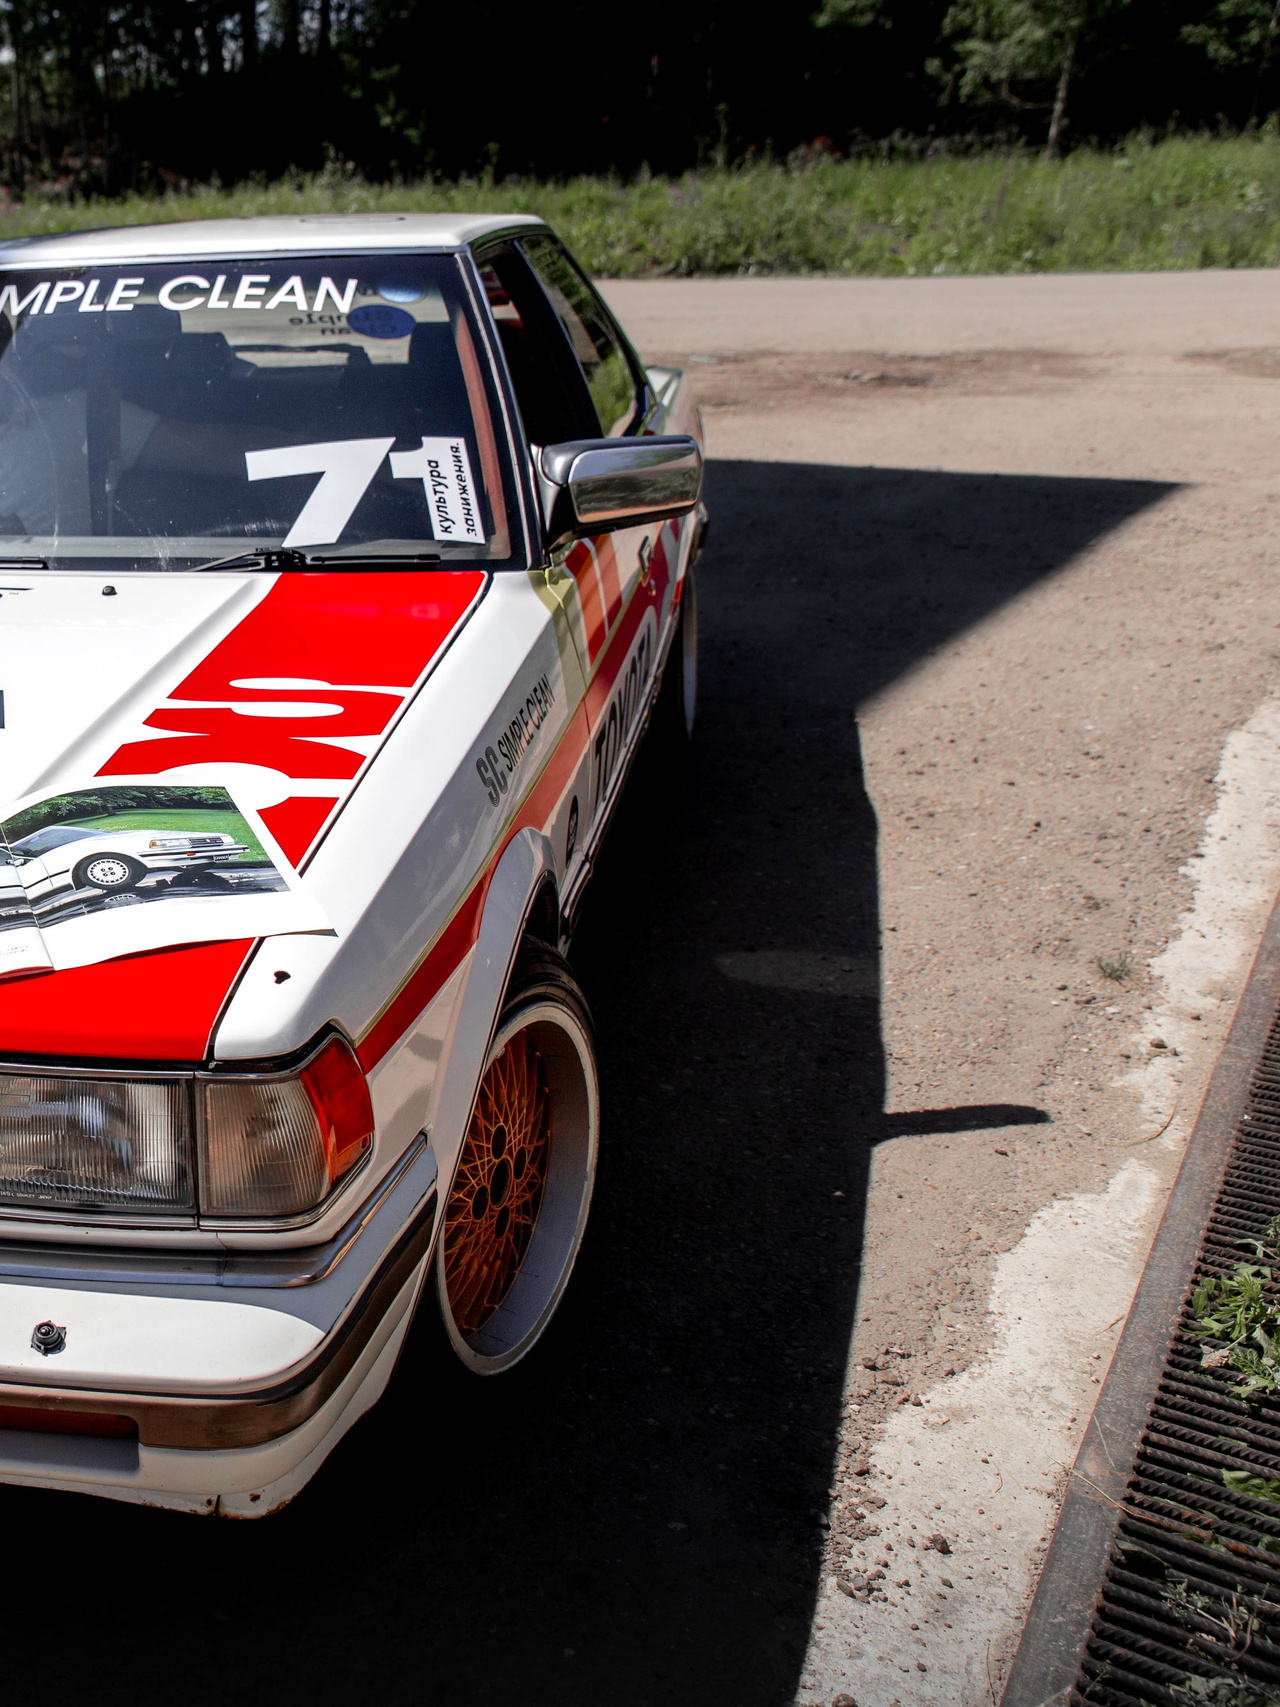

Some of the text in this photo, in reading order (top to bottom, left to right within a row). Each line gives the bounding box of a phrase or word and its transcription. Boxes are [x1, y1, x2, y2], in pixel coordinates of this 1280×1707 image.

[157, 274, 358, 314] CLEAN
[245, 435, 486, 548] 71
[497, 707, 535, 773] SIMPLE
[525, 673, 556, 731] CLEAN
